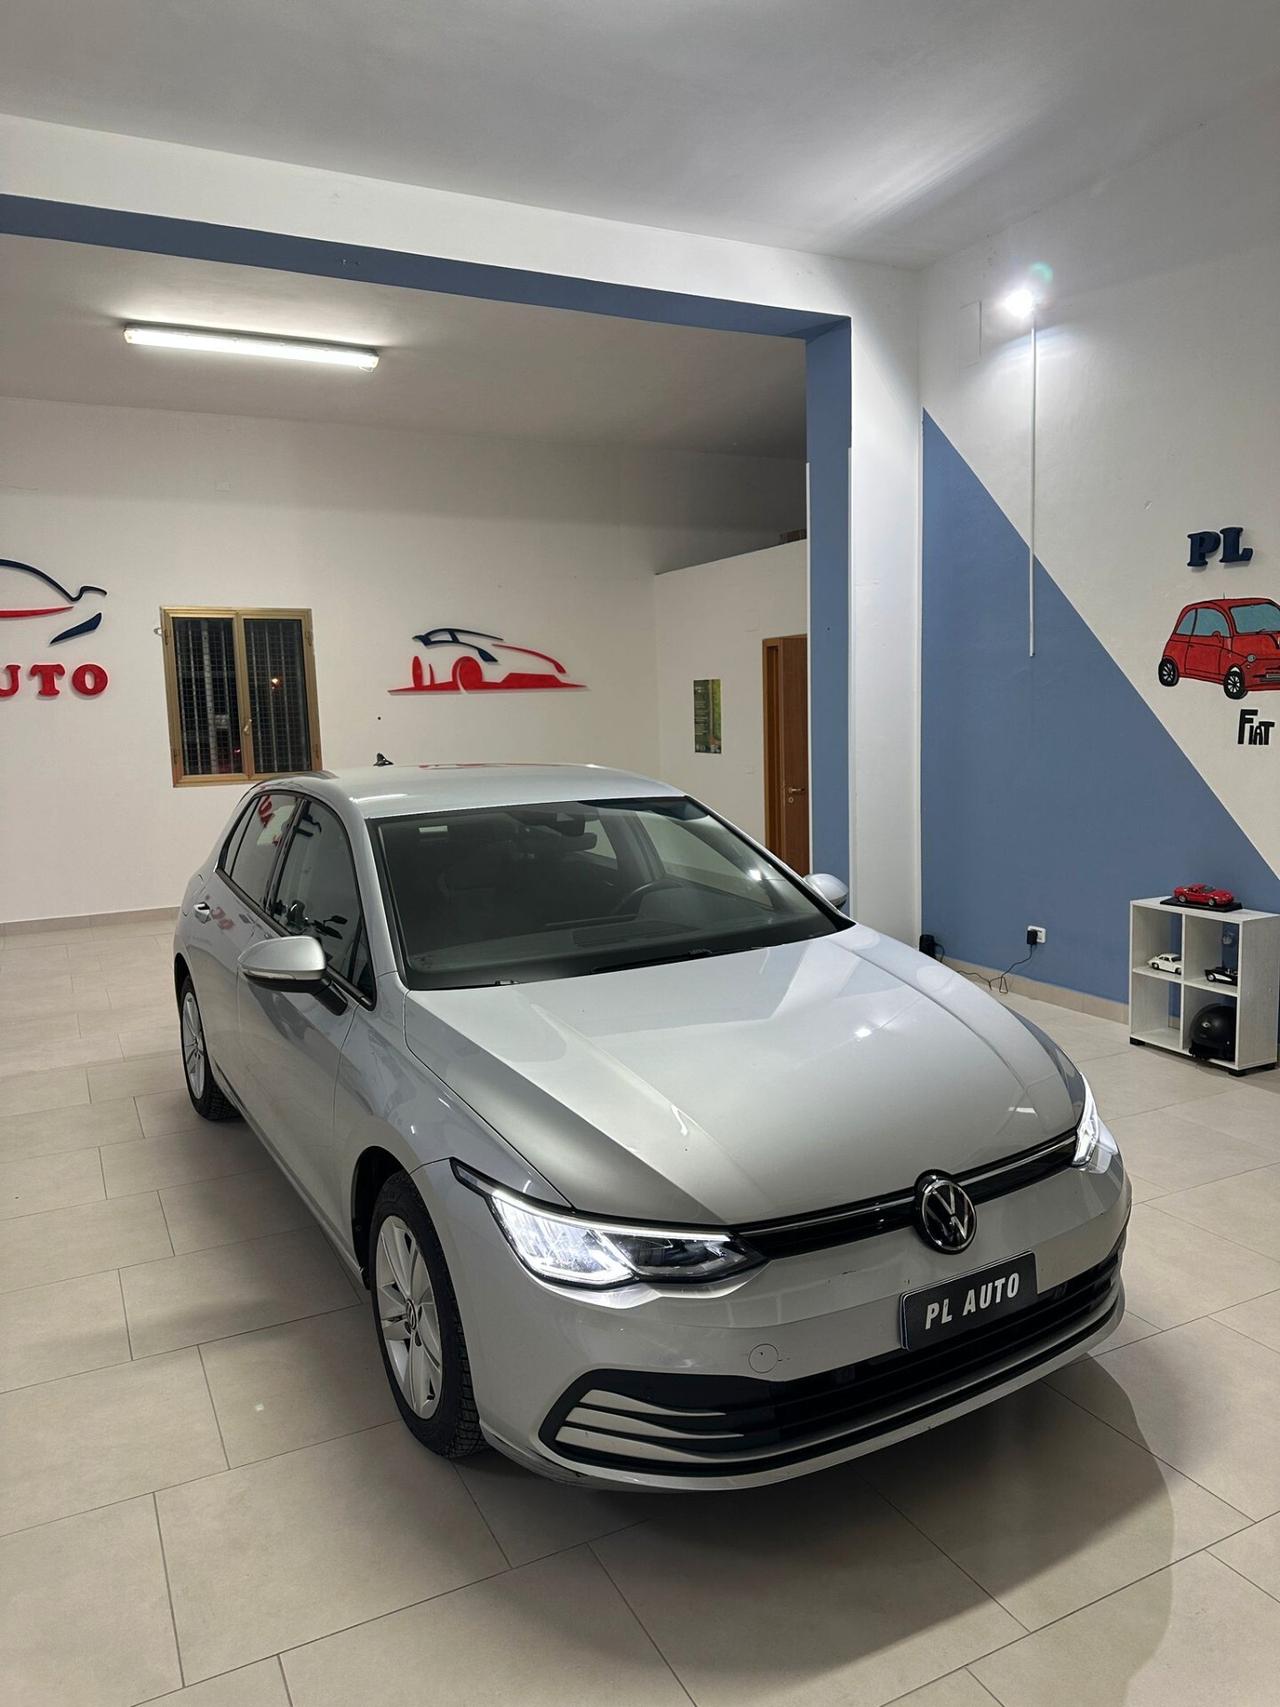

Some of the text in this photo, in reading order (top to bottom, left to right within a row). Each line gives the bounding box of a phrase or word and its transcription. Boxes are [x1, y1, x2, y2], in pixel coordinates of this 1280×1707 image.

[1187, 527, 1253, 567] PL
[925, 1272, 1020, 1330] PL AUTO
